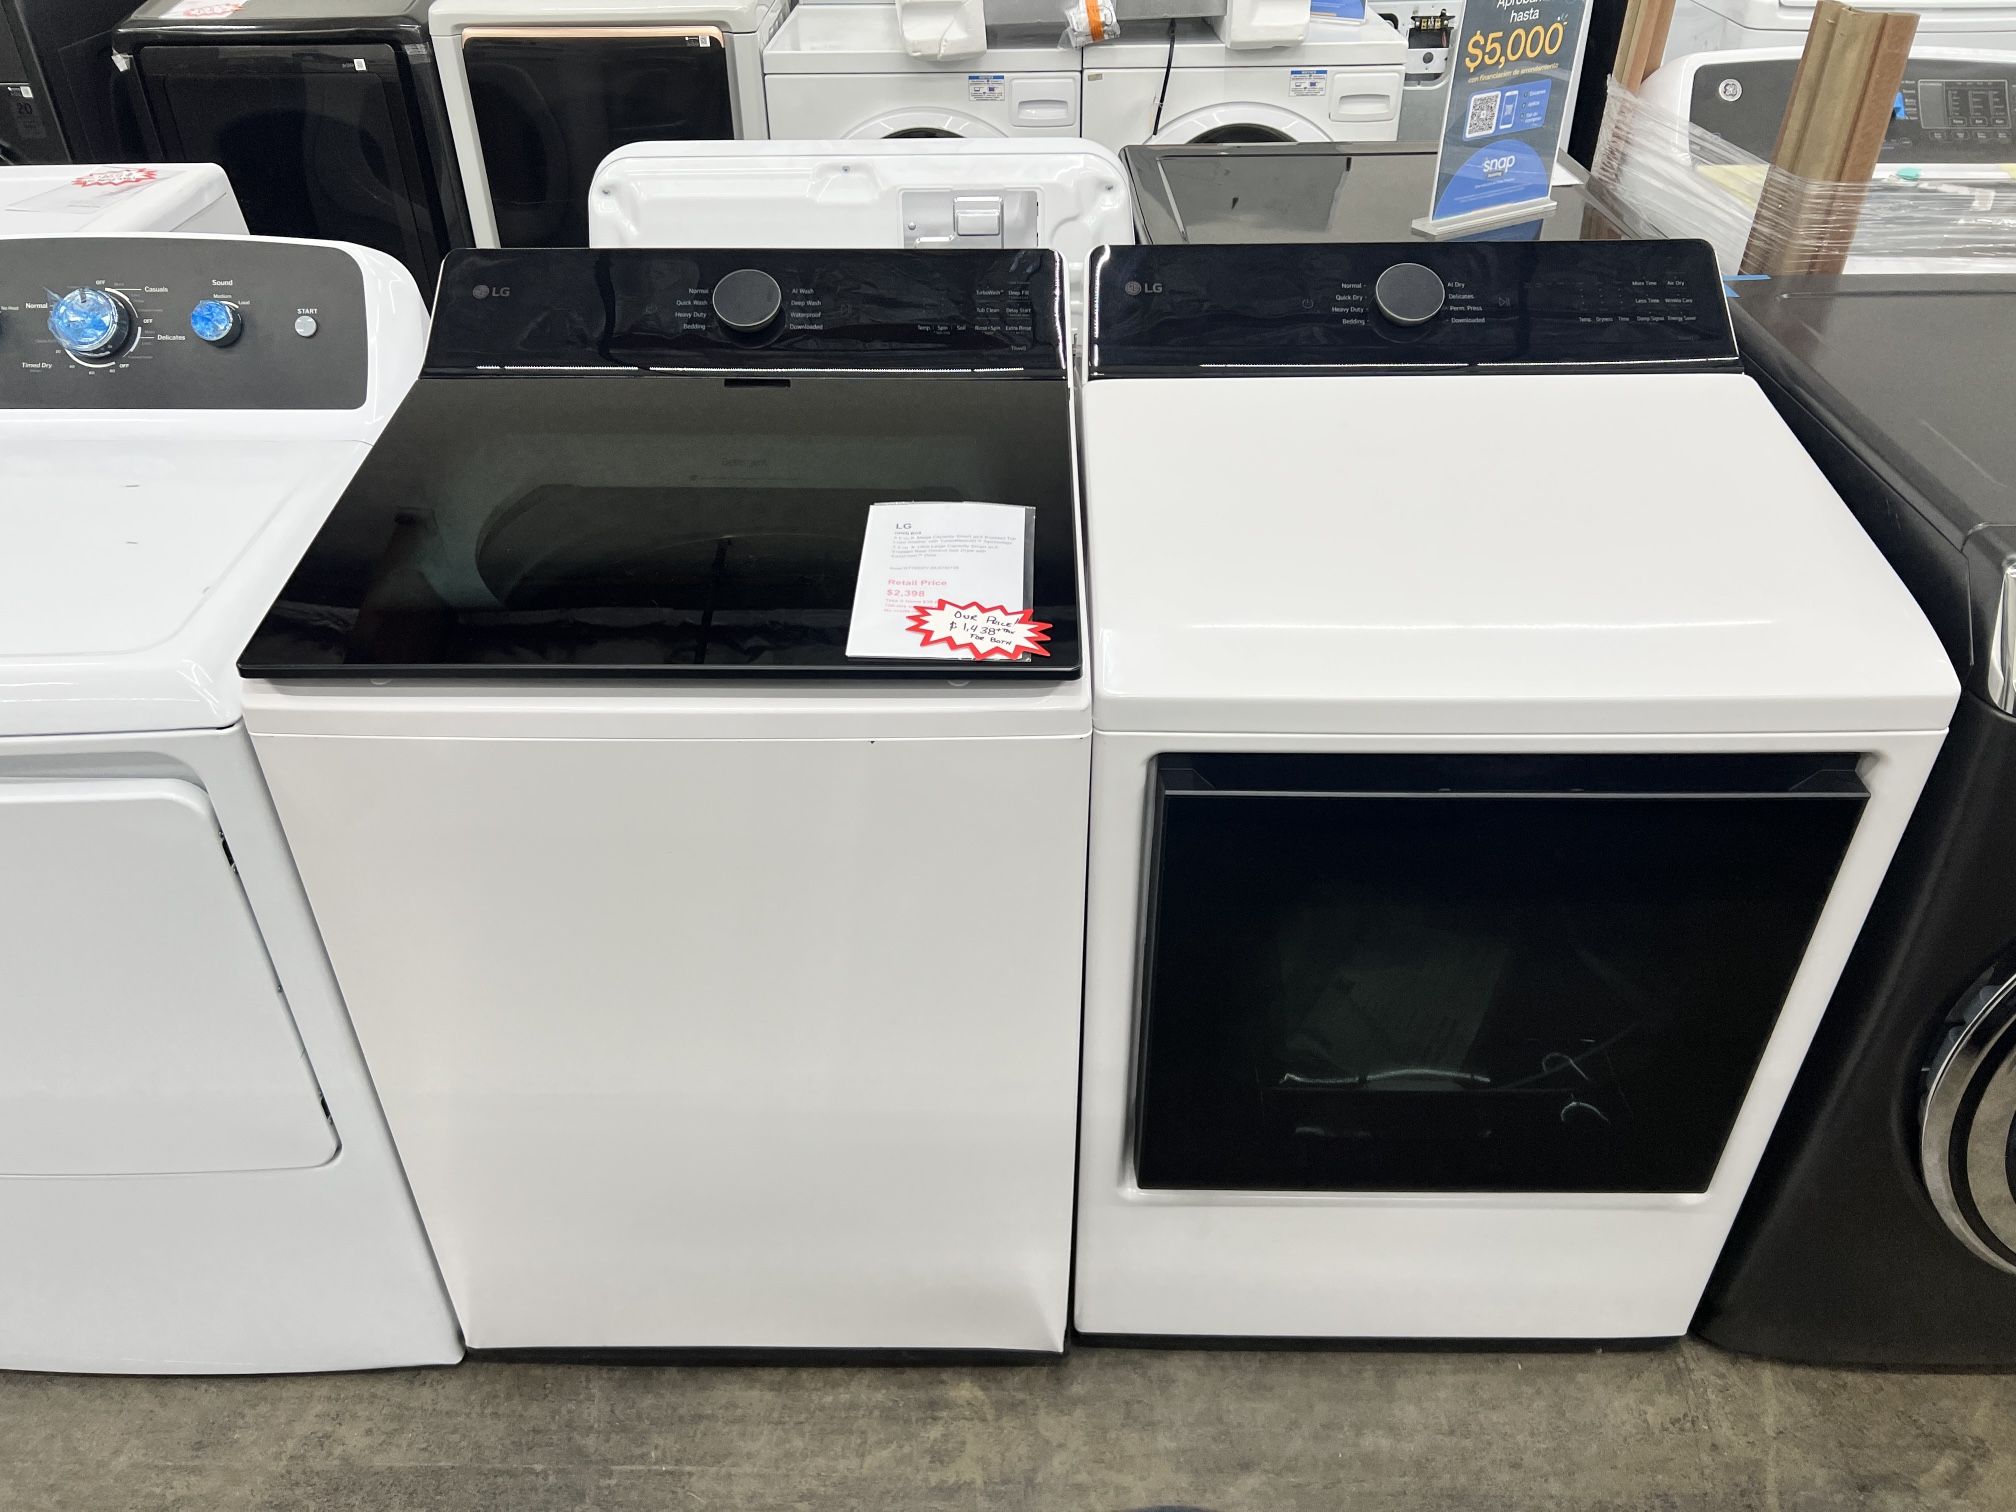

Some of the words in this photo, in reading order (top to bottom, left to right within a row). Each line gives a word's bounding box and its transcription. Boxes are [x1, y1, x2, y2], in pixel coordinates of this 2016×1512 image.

[1510, 8, 1540, 23] hasta
[1464, 22, 1564, 73] $5,000
[1482, 154, 1516, 174] snap
[1144, 282, 1163, 294] LG
[1454, 281, 1465, 289] Dry
[491, 286, 511, 297] LG
[1352, 294, 1363, 302] Dry
[42, 362, 53, 370] Dry
[920, 579, 948, 587] Price
[886, 589, 926, 598] $2,398
[954, 610, 978, 623] OUR
[990, 637, 1013, 646] BOTH
